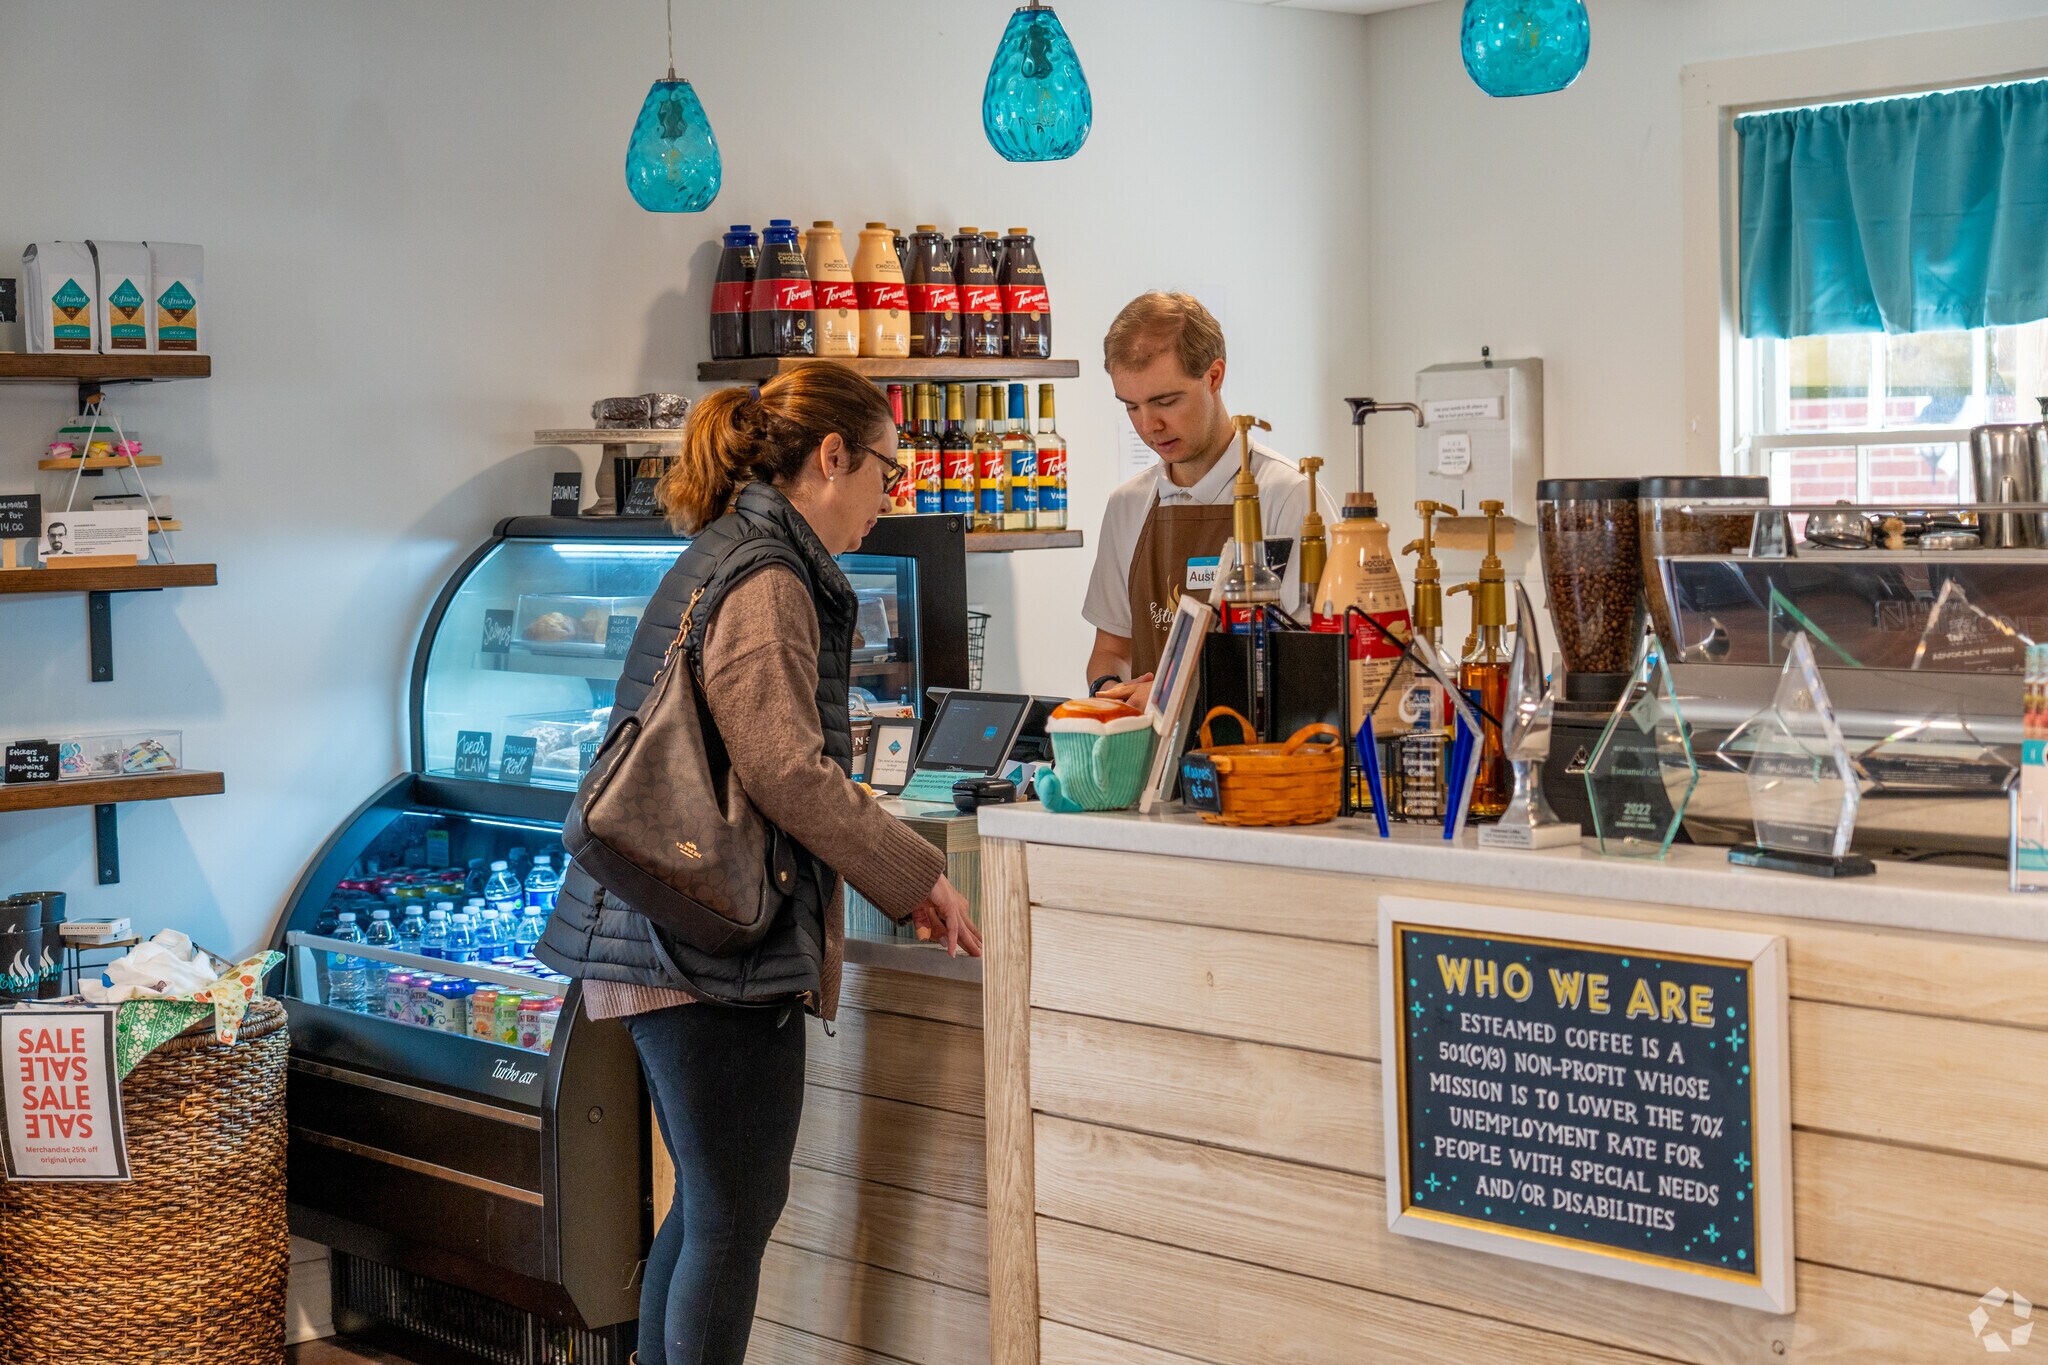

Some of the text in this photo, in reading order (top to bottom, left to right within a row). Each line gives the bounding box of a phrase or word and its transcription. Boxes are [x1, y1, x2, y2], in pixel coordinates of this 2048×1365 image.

[782, 285, 812, 305] Torani
[823, 286, 854, 305] Torani
[874, 286, 904, 305] Torani
[930, 289, 957, 307] Torani
[968, 290, 997, 309] Torani
[1014, 290, 1046, 309] Torani
[552, 485, 579, 501] BROWNIE
[9, 748, 37, 756] Stickers
[9, 763, 44, 772] Keychains
[457, 757, 487, 773] CLAW
[503, 757, 526, 775] Roll
[1408, 768, 1435, 777] Coffee
[1191, 785, 1213, 799] $5.00
[1623, 803, 1652, 816] 2022
[1436, 954, 1716, 1028] WHO WE ARE
[18, 1028, 86, 1054] SALE
[1460, 1012, 1685, 1065] ESTEAMED COFFEE IS A
[20, 1056, 88, 1082] SALE
[492, 1059, 538, 1084] Turbo air
[1438, 1041, 1711, 1101] 501(C)(3) NON-PROFIT WHOSE
[22, 1085, 91, 1110] SALE
[1429, 1072, 1724, 1139] MISSION IS TO LOWER THE 70%
[26, 1113, 93, 1139] SALE
[1449, 1106, 1705, 1170] UNEMPLOYMENT RATE FOR
[25, 1145, 98, 1154] Merchandise 25% off
[40, 1156, 87, 1165] original price
[1434, 1136, 1720, 1207] PEOPLE WITH SPECIAL NEEDS
[1475, 1175, 1676, 1231] AND/OR DISABILITIES
